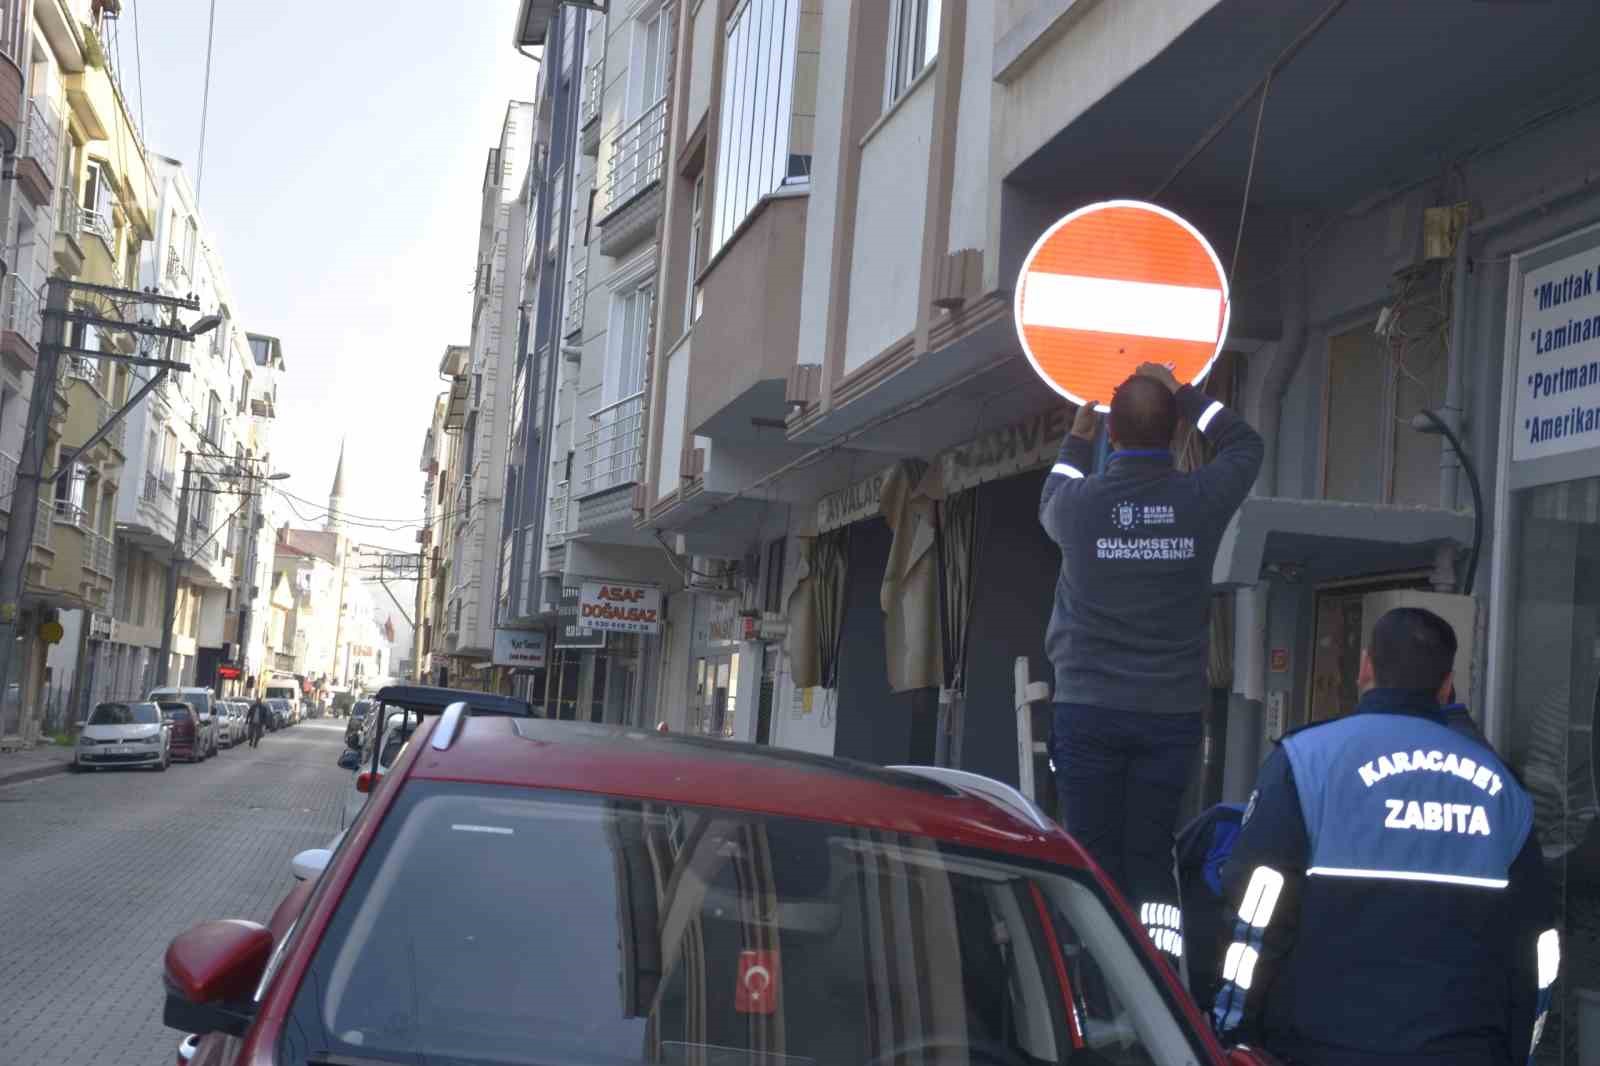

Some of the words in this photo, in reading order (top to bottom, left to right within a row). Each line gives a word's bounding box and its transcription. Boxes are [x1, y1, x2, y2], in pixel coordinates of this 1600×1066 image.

[1528, 361, 1600, 399] Portman
[598, 584, 645, 602] ASAF
[581, 603, 657, 623] DOĞALGAZ
[1358, 750, 1503, 796] KARACABEY
[1384, 799, 1491, 836] ZABITA
